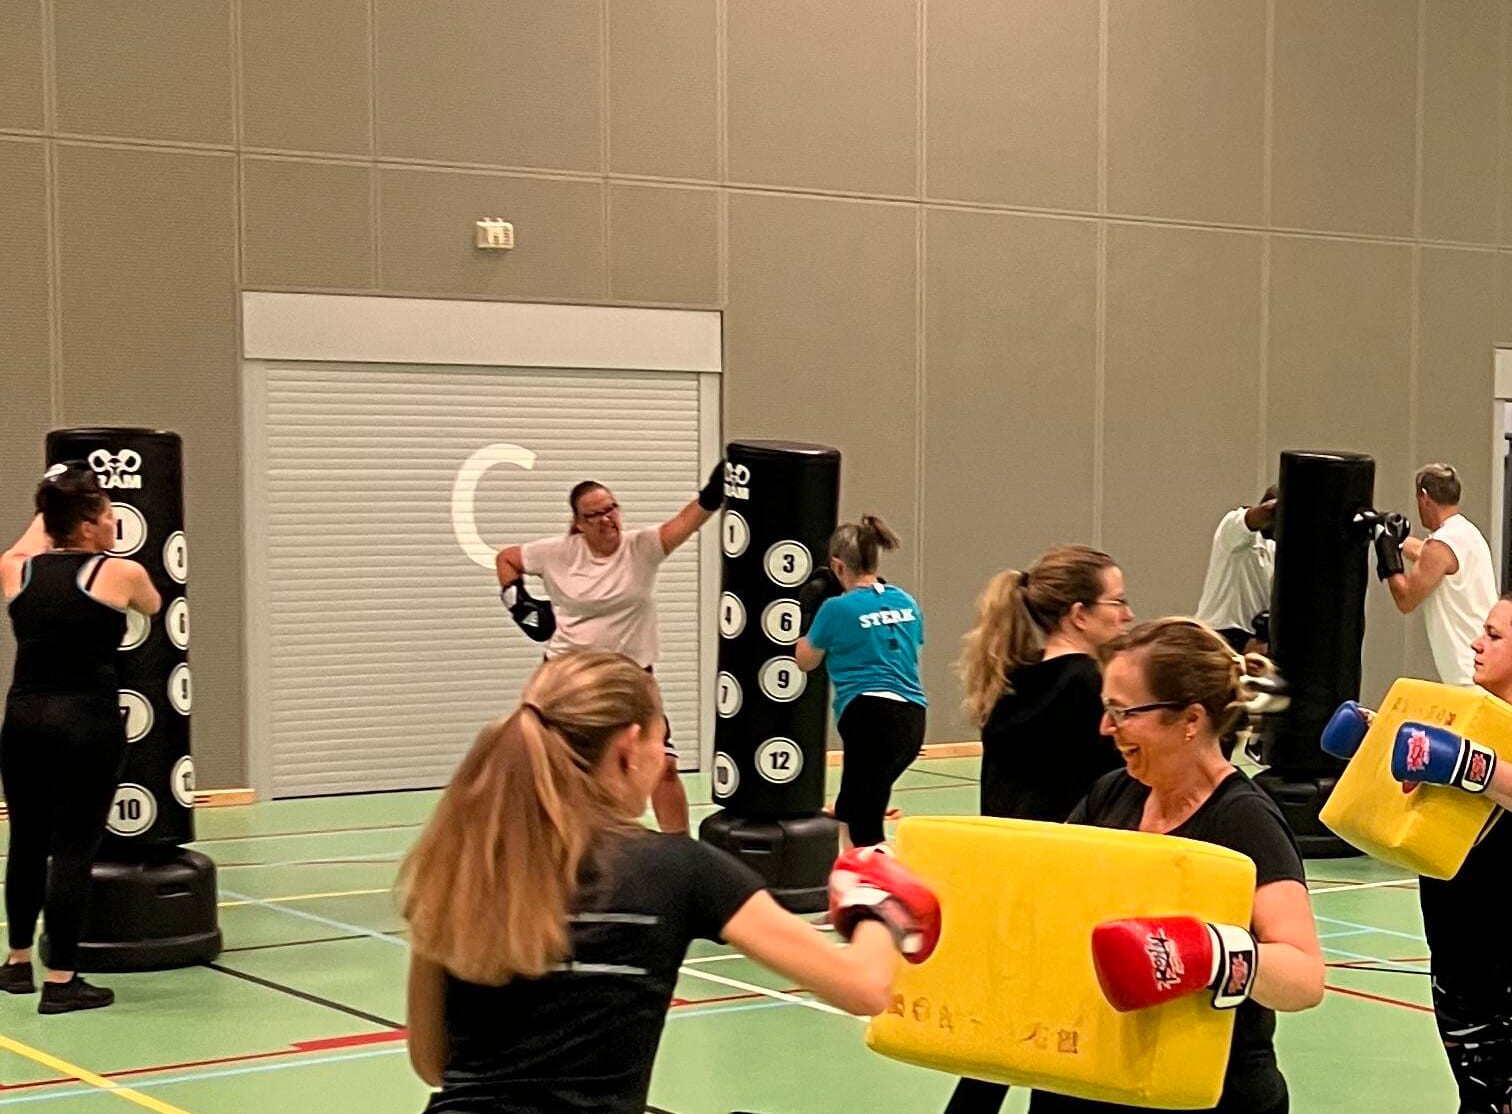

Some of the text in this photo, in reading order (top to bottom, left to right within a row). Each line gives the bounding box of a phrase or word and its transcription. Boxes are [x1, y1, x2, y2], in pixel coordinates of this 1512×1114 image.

[451, 442, 537, 570] C
[116, 518, 123, 540] 1
[729, 525, 735, 543] 1
[783, 553, 795, 573] 3
[780, 612, 793, 632] 6
[858, 608, 916, 629] STERK
[777, 670, 790, 689] 9
[722, 685, 729, 704] 7
[769, 751, 791, 770] 12
[115, 798, 141, 821] 10
